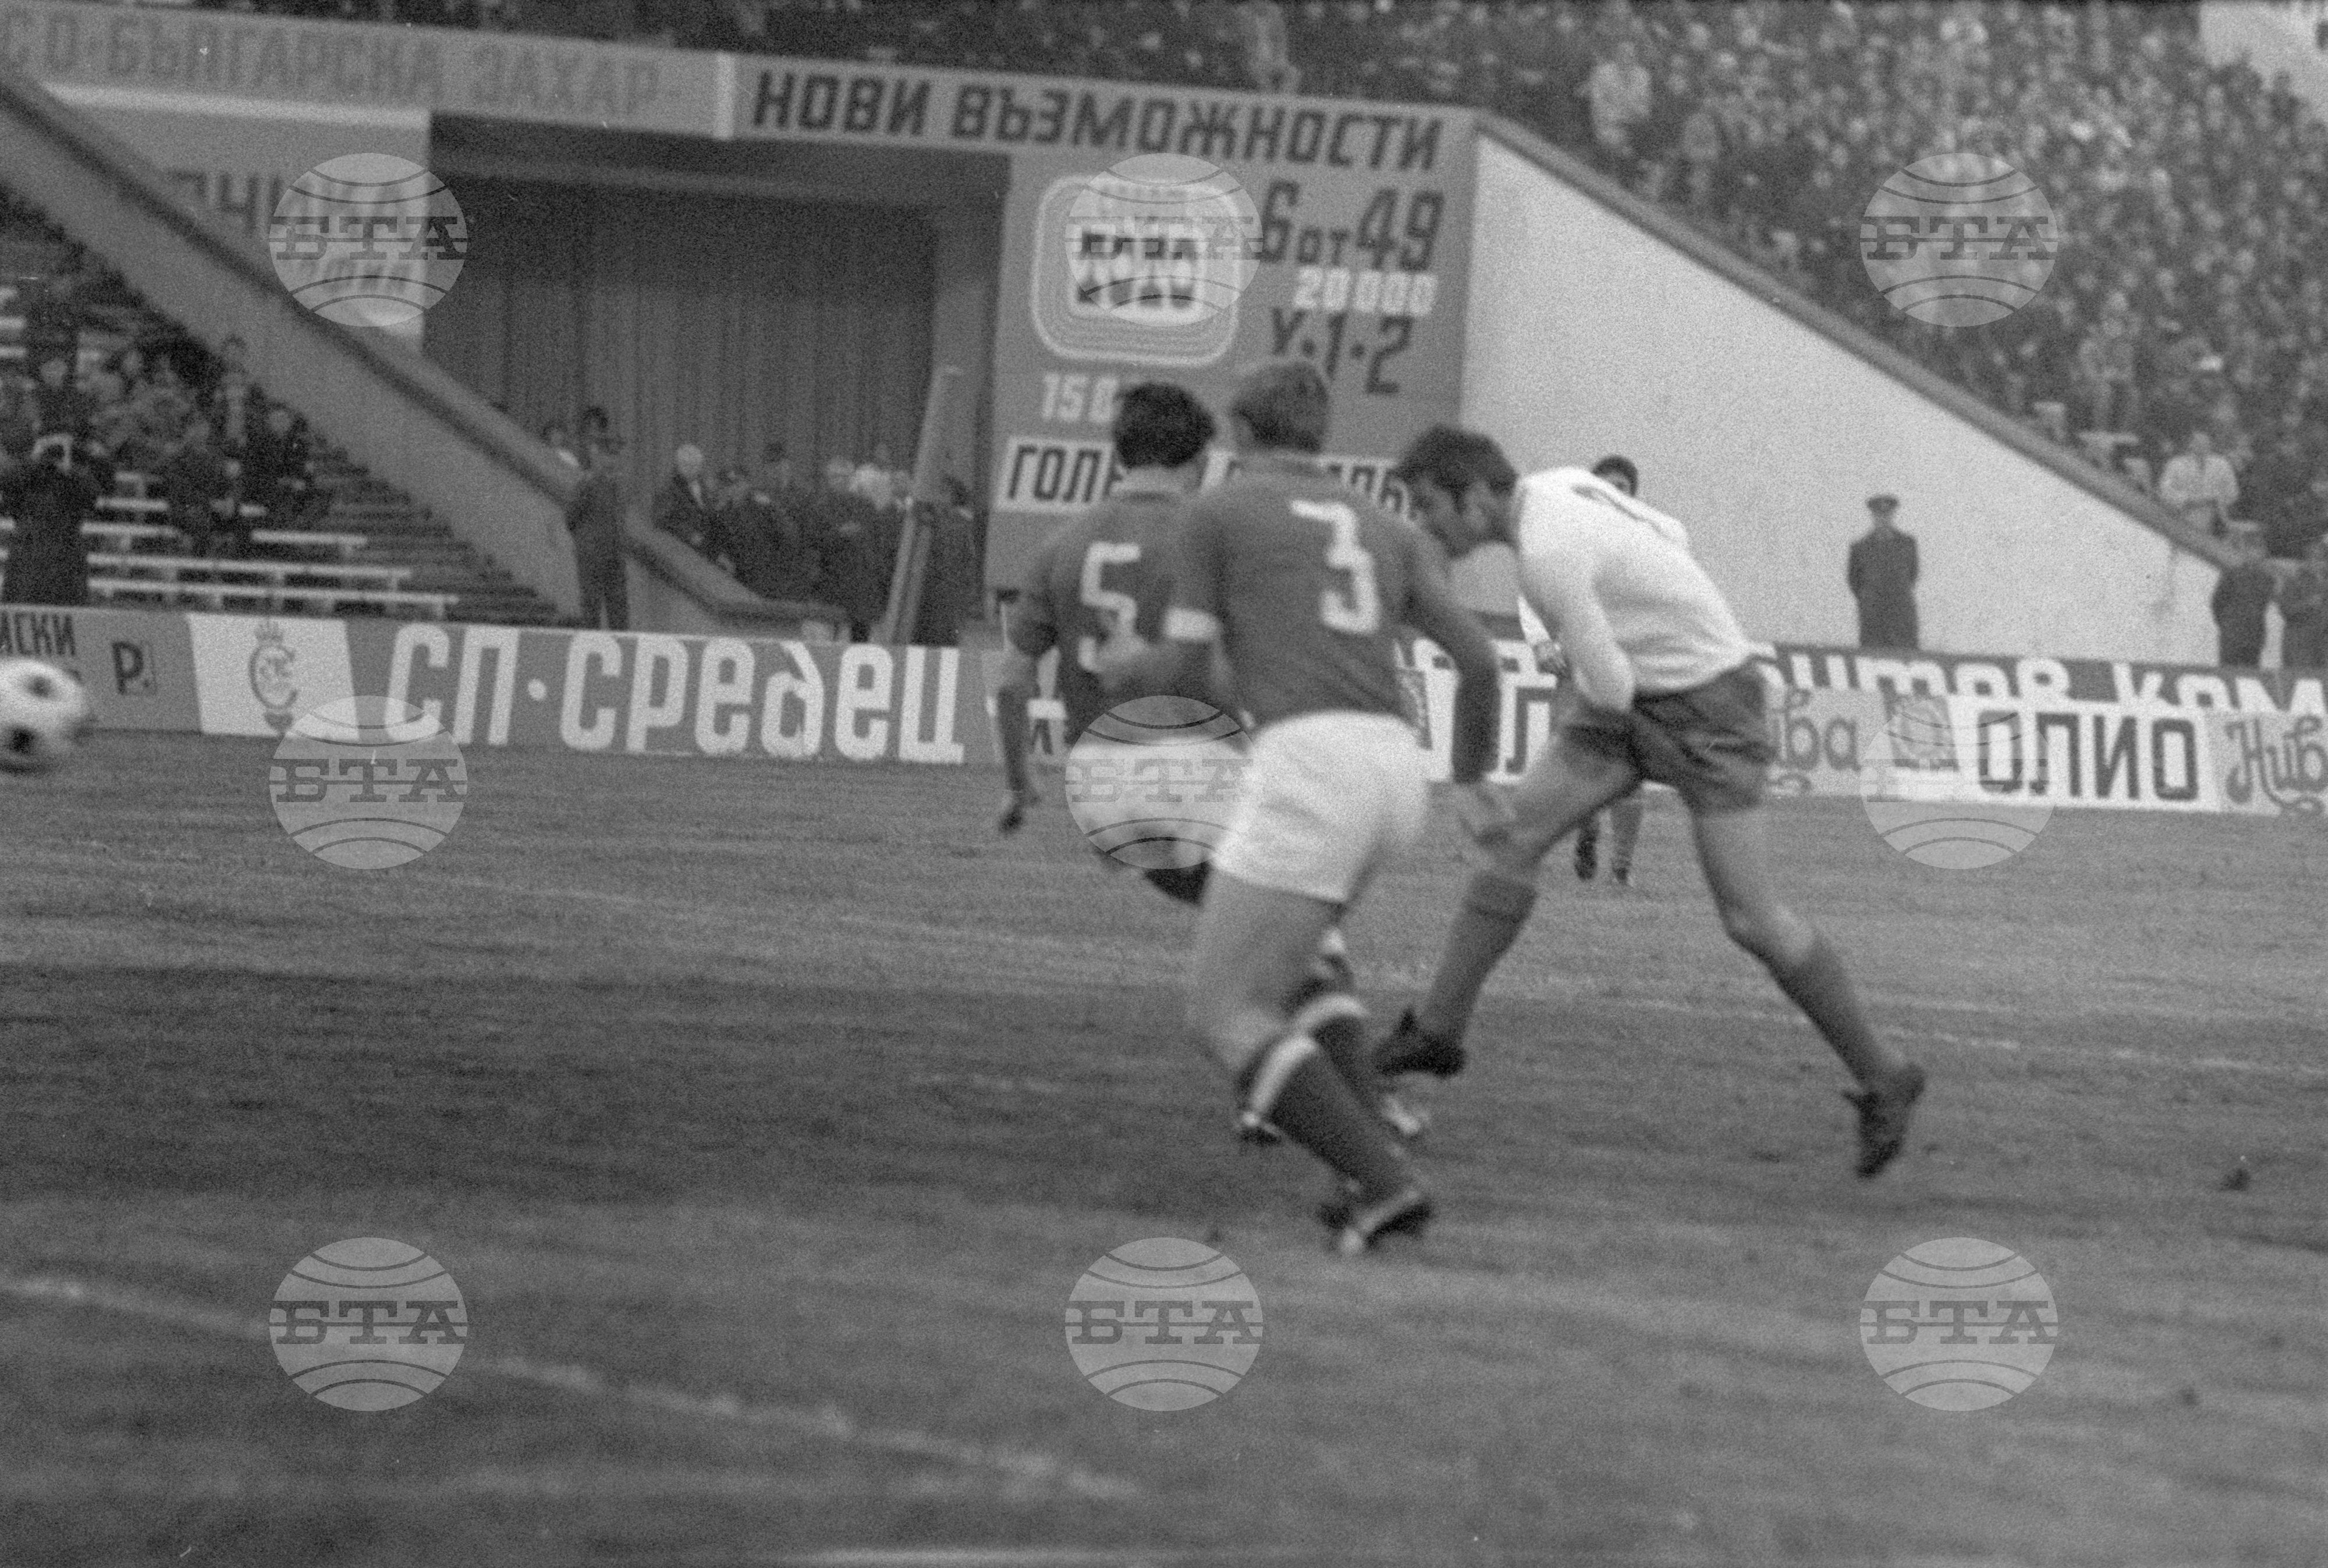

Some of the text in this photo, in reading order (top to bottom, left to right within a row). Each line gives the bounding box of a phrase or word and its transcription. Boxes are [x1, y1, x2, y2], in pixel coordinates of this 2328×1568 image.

[754, 70, 1442, 170] НОВИ ВЪЗМОЖНОСТИ
[1257, 179, 1446, 271] 6 от 49
[1080, 541, 1144, 672] 5
[1290, 498, 1382, 636] 3
[1979, 708, 2201, 802] ОЛИО
